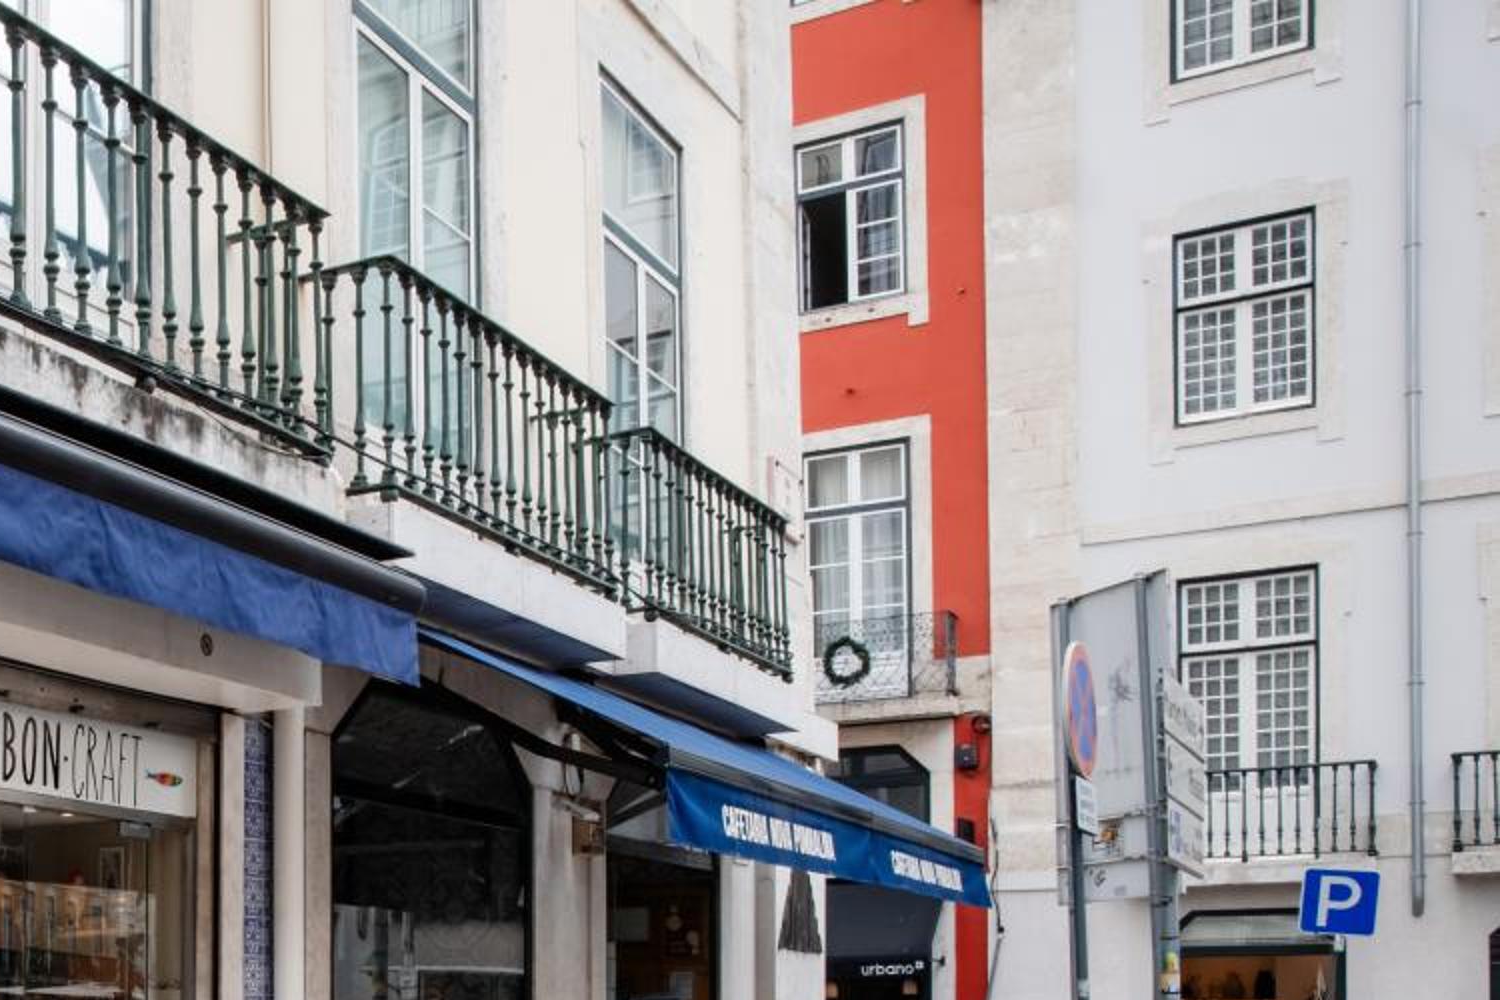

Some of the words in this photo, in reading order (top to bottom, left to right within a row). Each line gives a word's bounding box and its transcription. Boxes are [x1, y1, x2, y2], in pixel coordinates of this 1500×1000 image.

[71, 723, 143, 809] CRAFT
[1315, 875, 1362, 927] P
[861, 962, 915, 976] urbano
